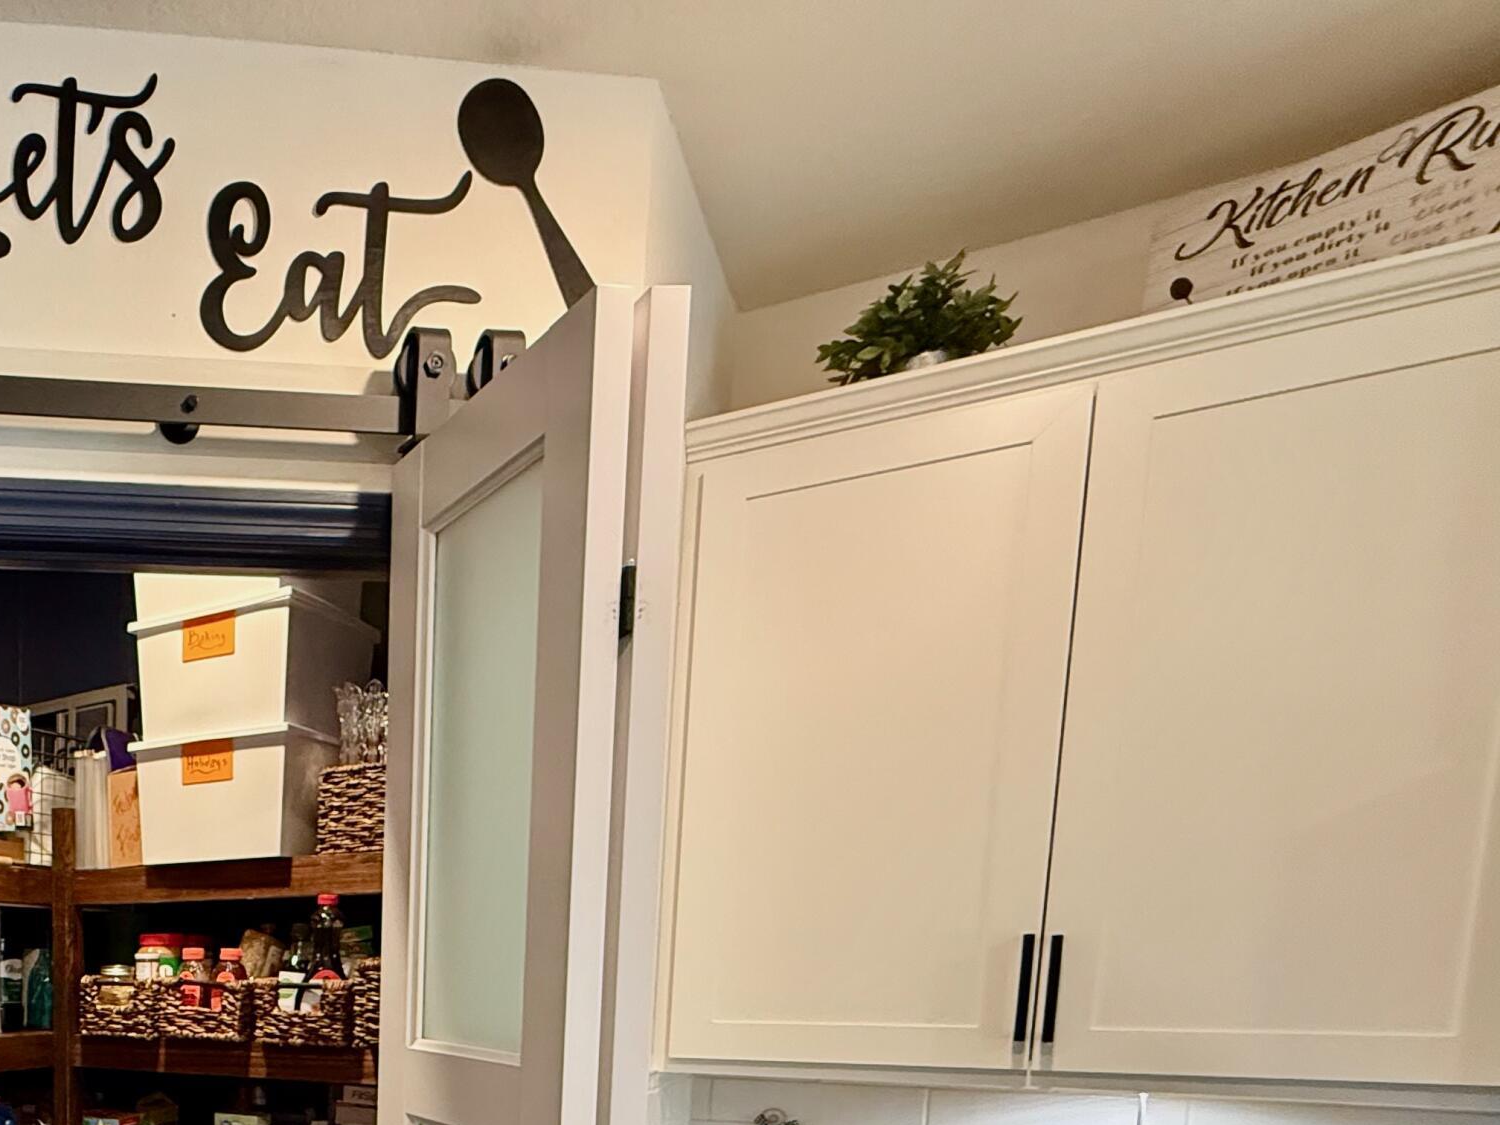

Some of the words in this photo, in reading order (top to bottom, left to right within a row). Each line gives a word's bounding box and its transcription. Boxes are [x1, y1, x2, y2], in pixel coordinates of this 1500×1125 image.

[1174, 165, 1376, 261] Kitchen
[1294, 220, 1357, 248] empty
[198, 169, 482, 359] Eat
